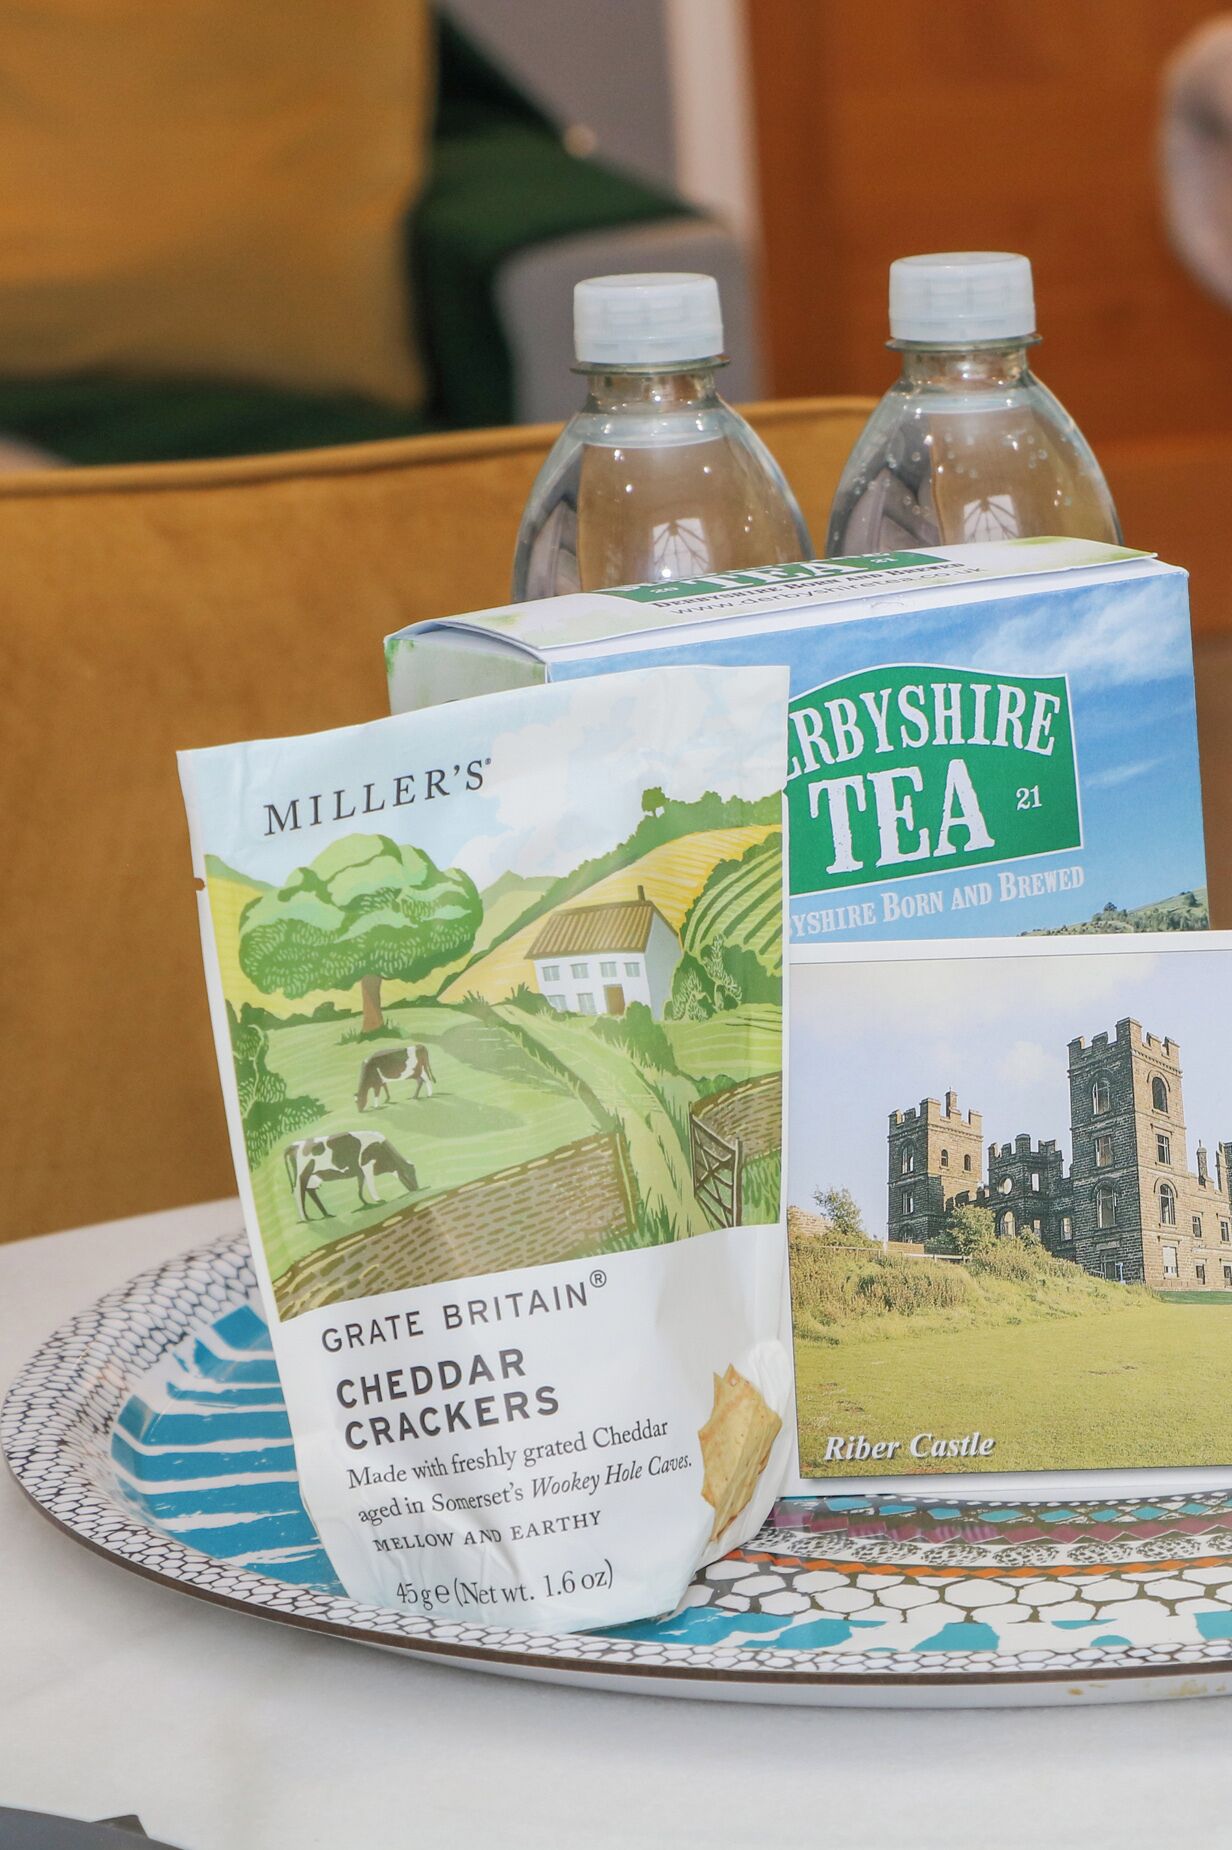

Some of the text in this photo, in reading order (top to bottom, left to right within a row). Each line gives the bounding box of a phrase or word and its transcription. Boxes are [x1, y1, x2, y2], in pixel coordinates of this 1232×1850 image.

[652, 584, 784, 608] DERBYSHIRE
[670, 567, 986, 615] www.derbyshiretea.co.uk
[680, 562, 868, 589] TEA
[807, 759, 996, 875] TEA
[1015, 785, 1042, 811] 21
[789, 866, 1085, 937] YSHIRE BORN AND BREWED
[322, 1311, 424, 1353] GRATE
[336, 1347, 527, 1409] CHEDDAR
[345, 1386, 560, 1451] CRACKERS
[346, 1418, 669, 1489] Made with freshly grated Cheddar
[823, 1432, 995, 1462] Riber Castle
[358, 1454, 692, 1526] aged in Somerset’s Wookey Hole Caves.
[373, 1511, 602, 1553] MELLOW AND EARTHY
[453, 1578, 498, 1611] (Net
[501, 1583, 535, 1604] wt.
[544, 1568, 576, 1598] 1.6
[580, 1559, 614, 1589] oz)
